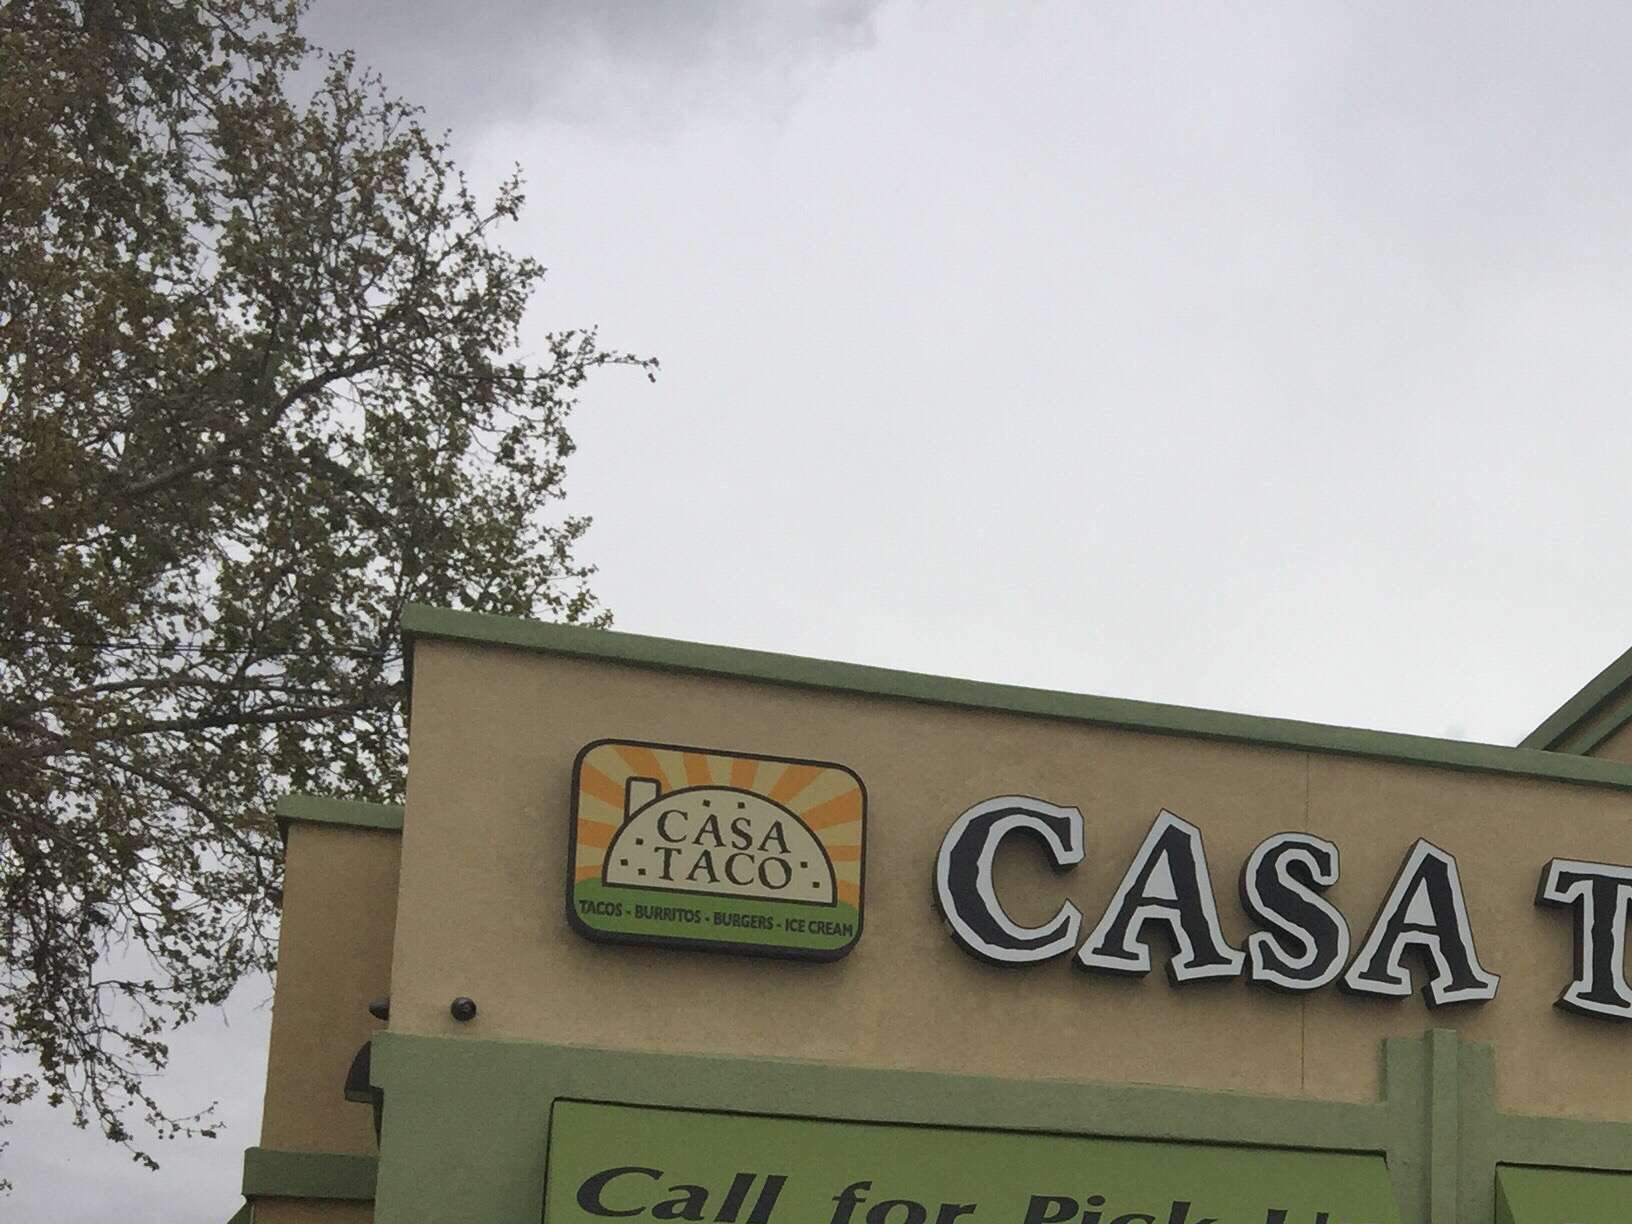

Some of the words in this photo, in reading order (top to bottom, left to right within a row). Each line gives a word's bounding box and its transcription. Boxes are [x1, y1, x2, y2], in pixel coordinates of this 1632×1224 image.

[655, 808, 792, 855] CASA
[653, 846, 793, 891] TACO
[578, 899, 624, 918] TACOS
[633, 903, 702, 925] BURRITOS
[712, 910, 775, 931] BURGERS
[784, 918, 806, 934] ICE
[807, 920, 855, 938] CREAM
[935, 794, 1501, 1008] CASA
